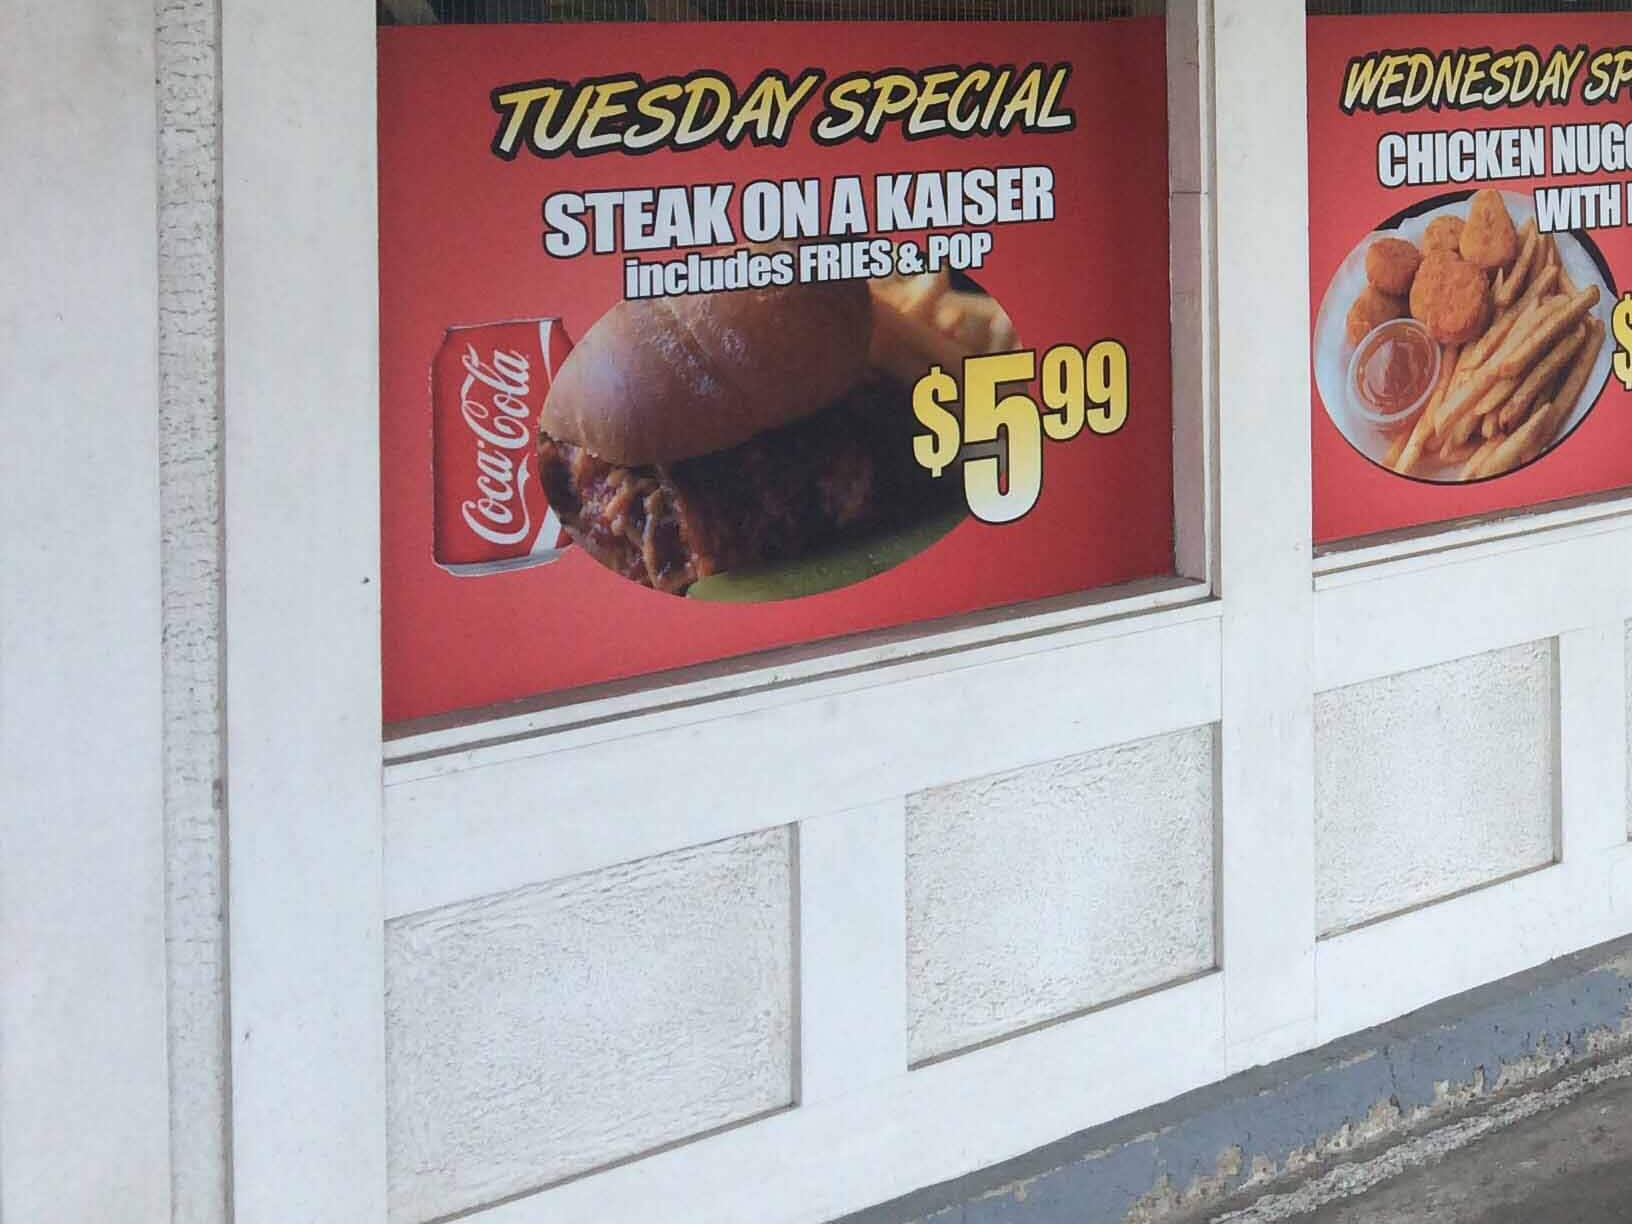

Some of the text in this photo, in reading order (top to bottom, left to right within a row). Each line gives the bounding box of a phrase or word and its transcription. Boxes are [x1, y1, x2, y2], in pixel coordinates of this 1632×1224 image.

[493, 65, 1075, 157] TUESDAY SPECIAL
[1342, 47, 1587, 111] WEDNESDAY
[1377, 127, 1547, 188] CHICKEN
[542, 166, 1055, 258] STEAK ON A KAISER
[1534, 183, 1618, 233] WITH
[624, 232, 993, 300] includes FRIES & POP
